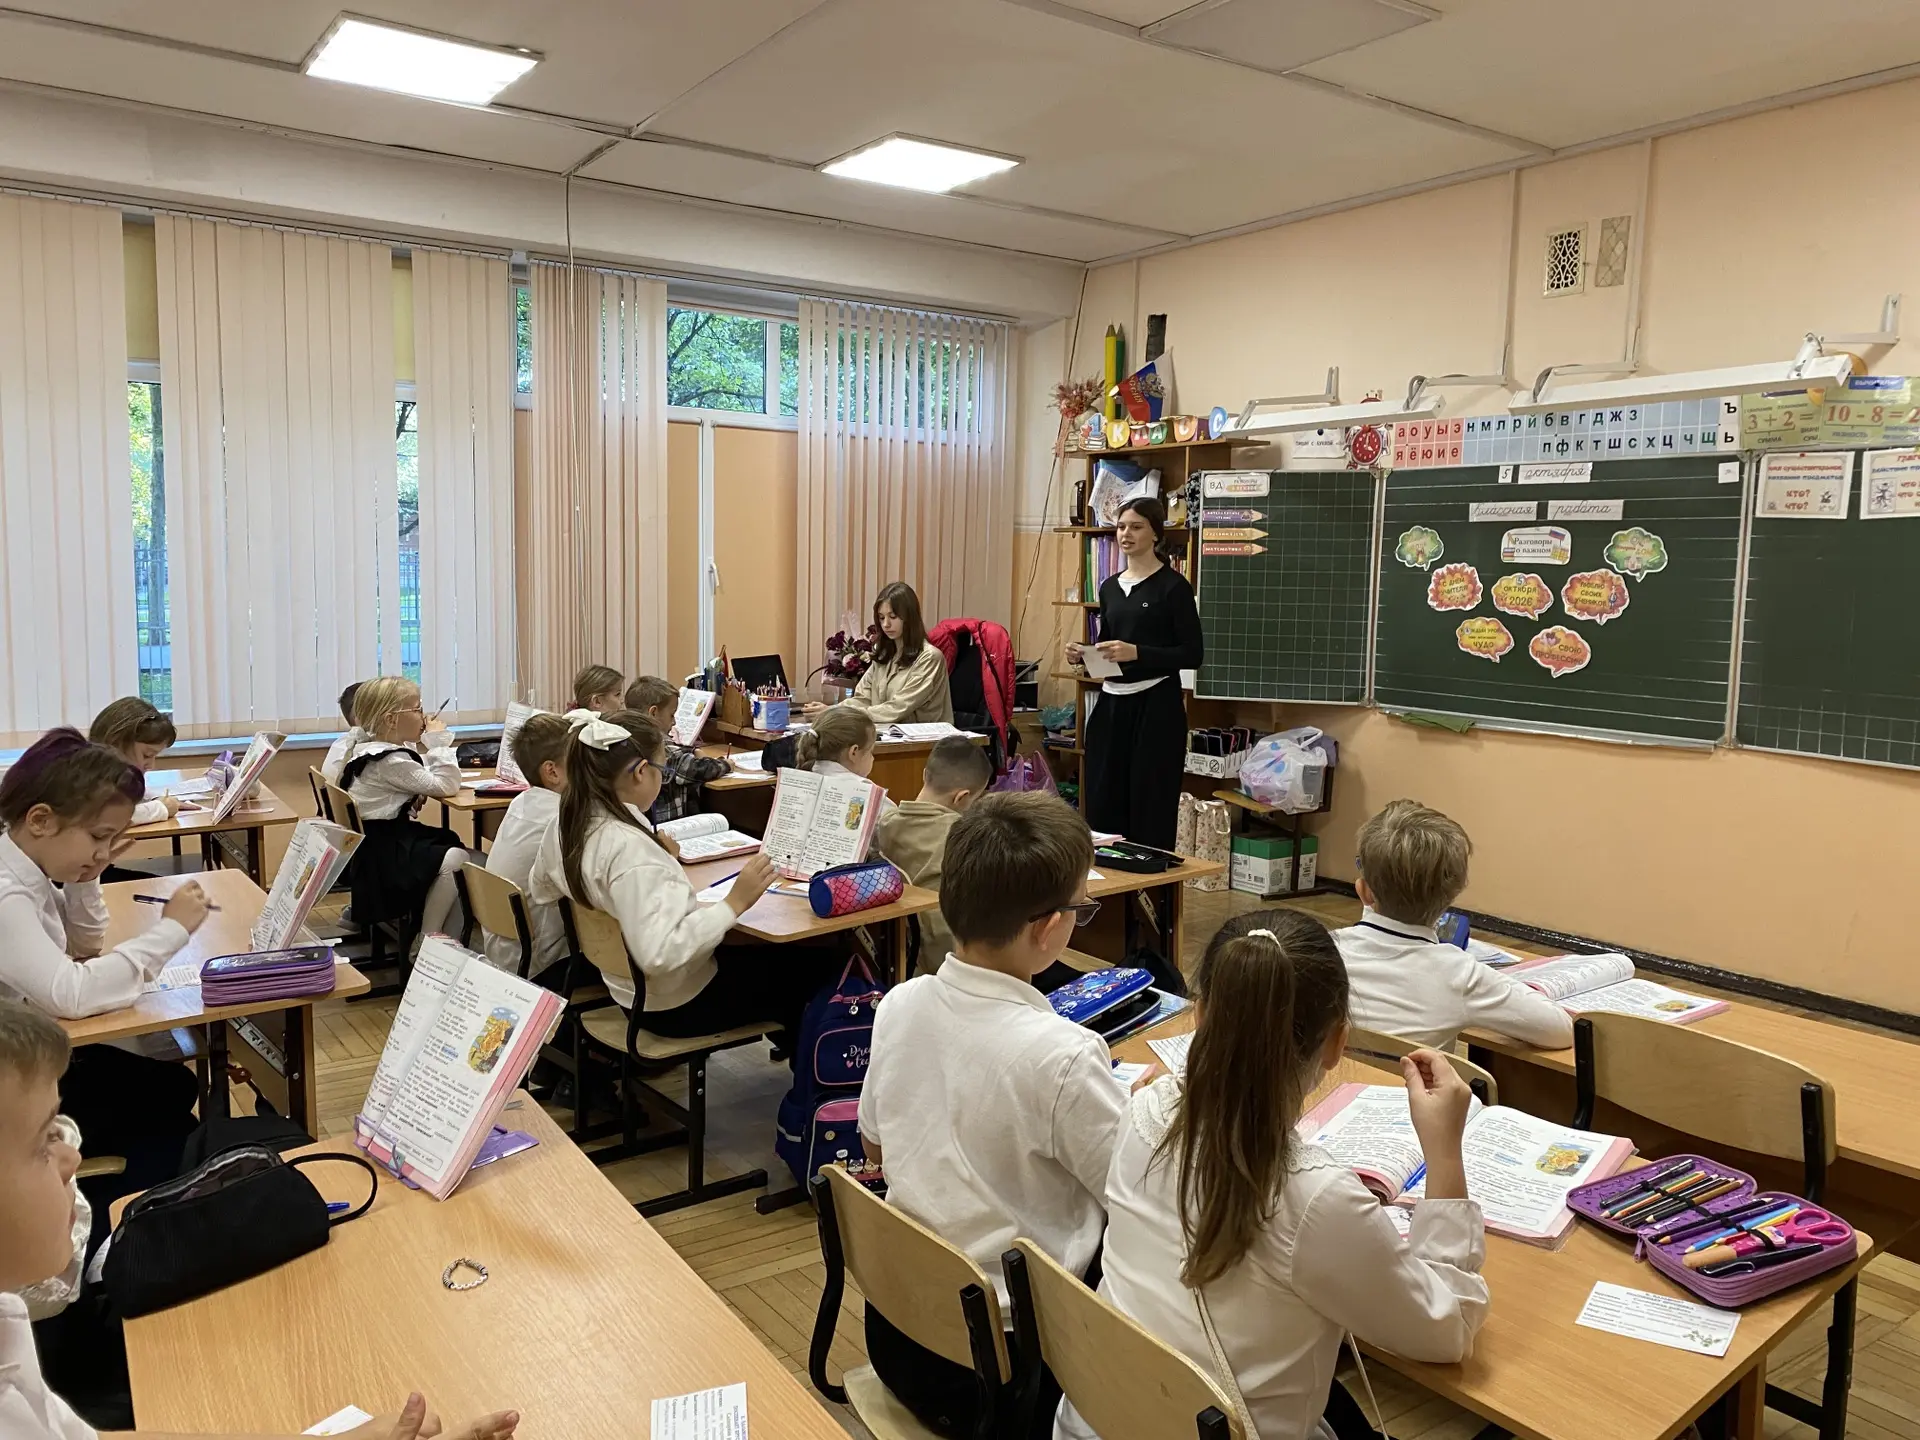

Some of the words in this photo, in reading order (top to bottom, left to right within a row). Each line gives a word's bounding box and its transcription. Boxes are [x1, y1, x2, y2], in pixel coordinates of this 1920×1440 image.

[1828, 406, 1850, 422] 10
[1871, 406, 1884, 423] 8
[1088, 414, 1101, 436] 1
[1748, 414, 1757, 430] 3
[1764, 414, 1777, 426] +
[1784, 411, 1793, 426] 2
[1502, 468, 1510, 479] 5
[1786, 489, 1811, 498] КТО?
[1785, 502, 1809, 510] ЧТО?
[1514, 537, 1553, 546] Разговоры
[1503, 585, 1537, 595] октября
[1473, 641, 1494, 649] ЧУДО
[1558, 644, 1581, 654] СВОЮ
